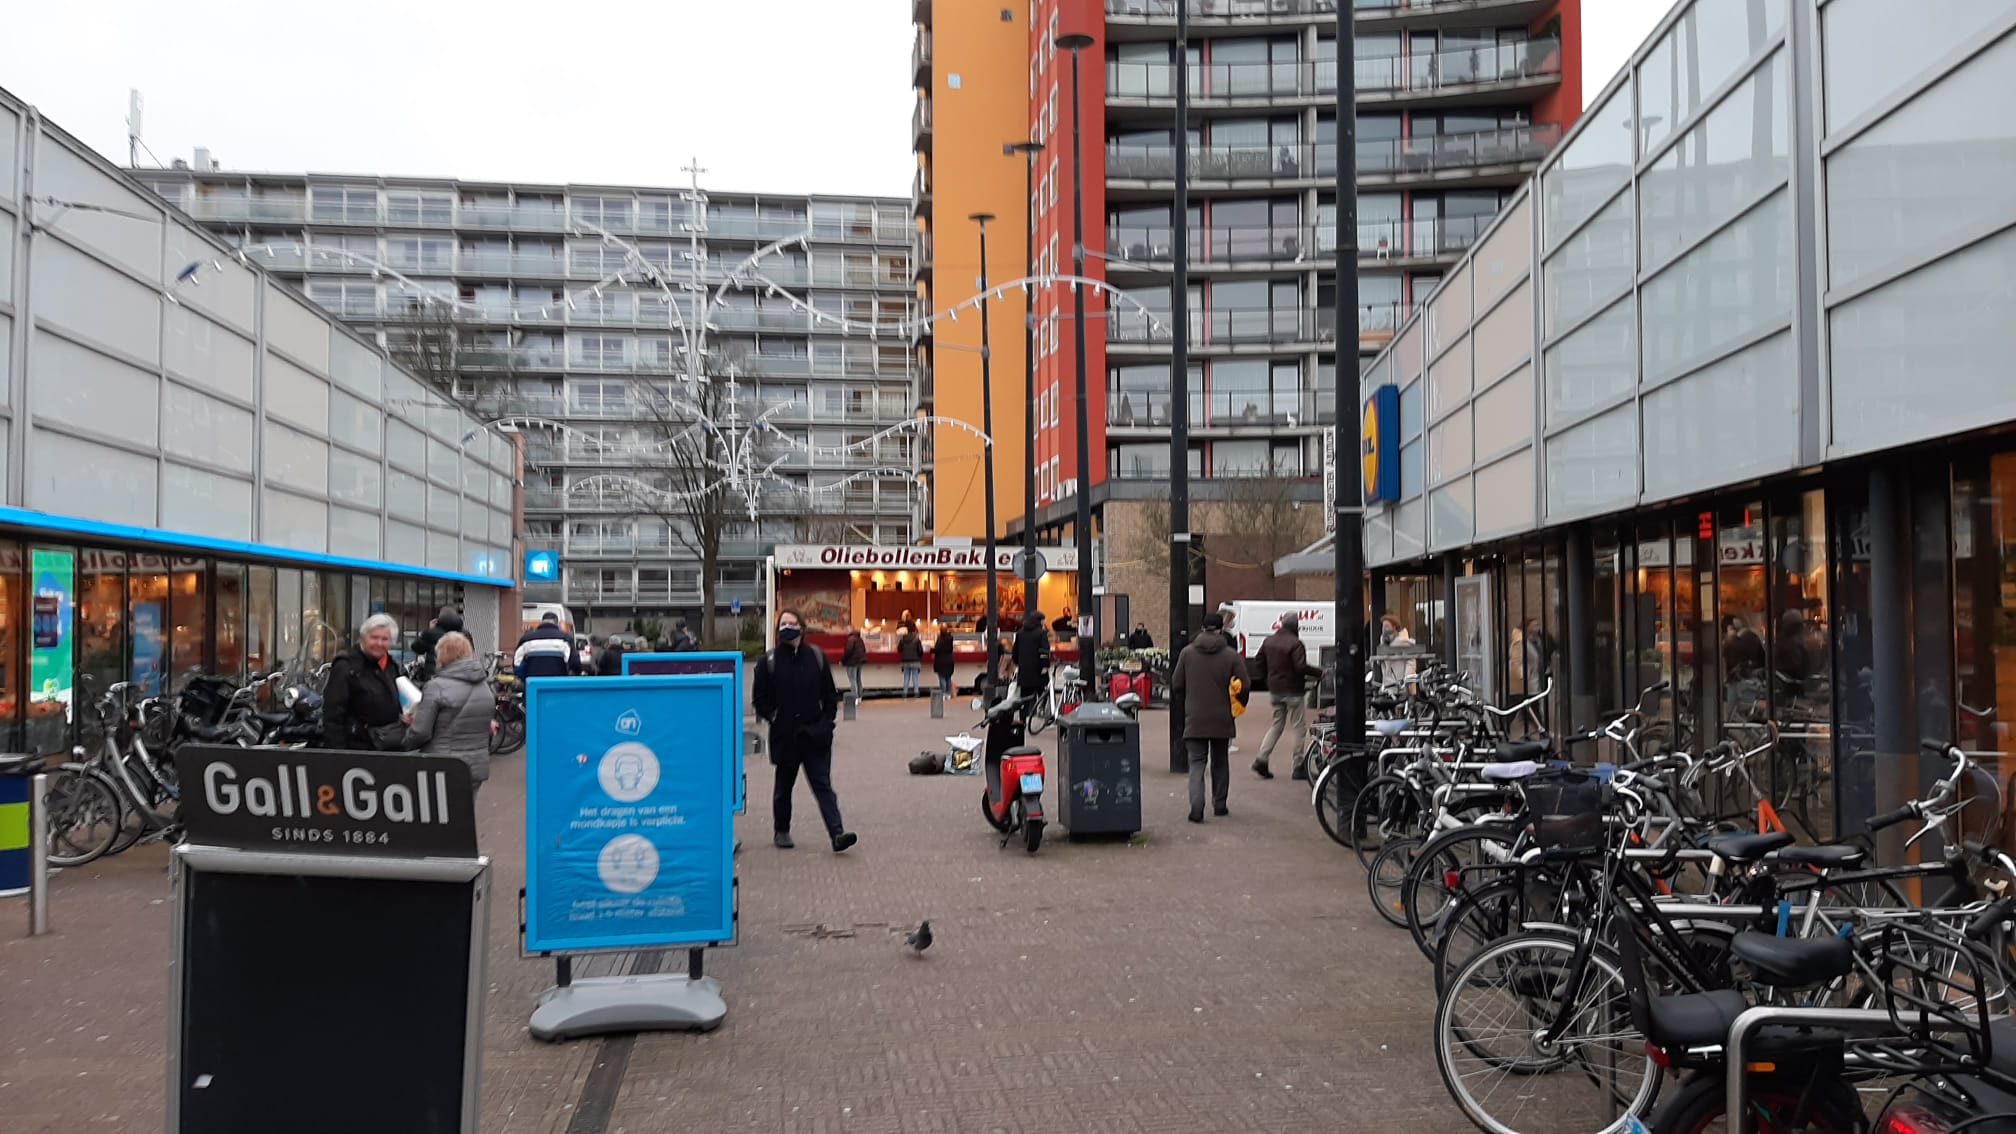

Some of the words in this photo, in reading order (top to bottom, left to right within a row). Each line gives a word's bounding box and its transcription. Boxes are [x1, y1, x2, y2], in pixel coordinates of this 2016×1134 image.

[821, 546, 1015, 565] OliebollenBake
[580, 807, 597, 817] Het
[601, 806, 635, 818] dragen
[638, 806, 656, 815] van
[659, 805, 677, 815] een
[570, 818, 627, 829] mondkapje
[271, 827, 335, 843] SINDS
[343, 830, 390, 845] 1884
